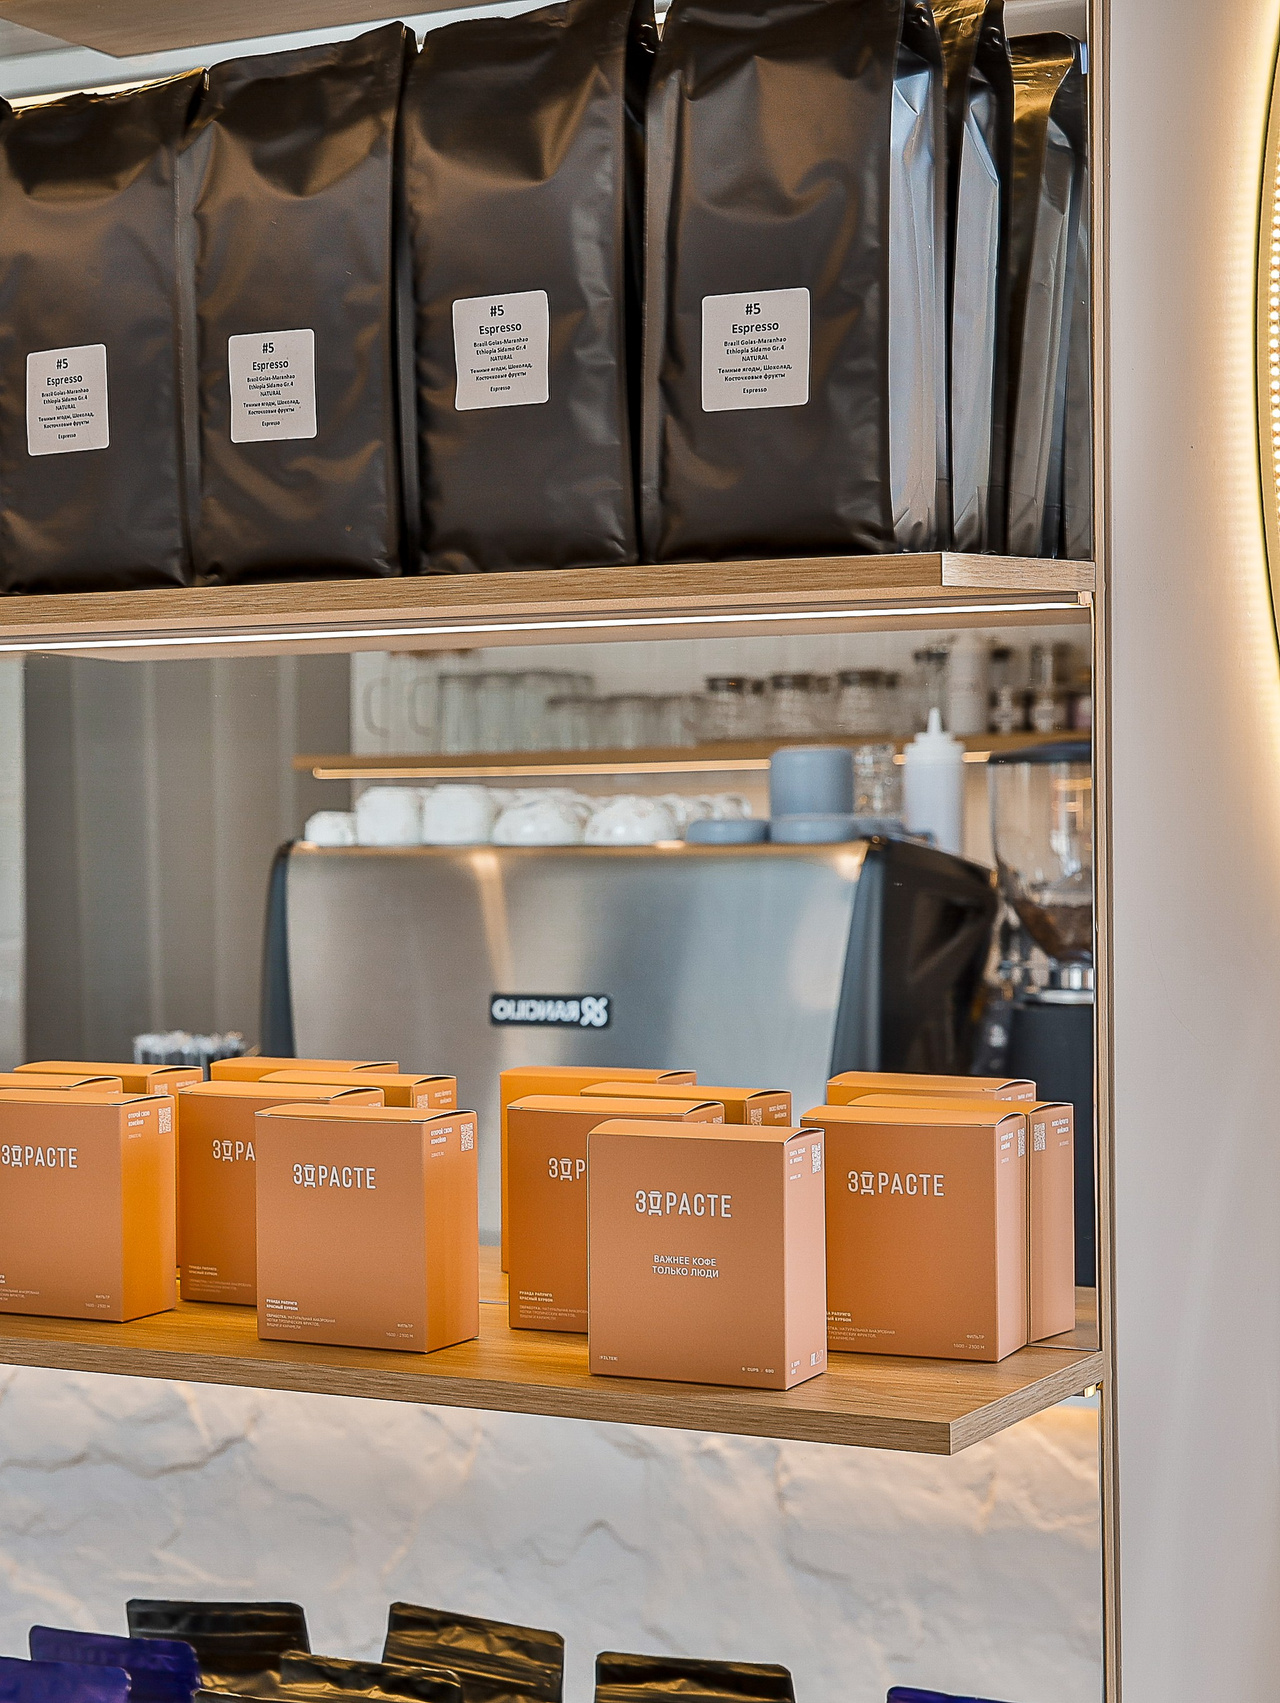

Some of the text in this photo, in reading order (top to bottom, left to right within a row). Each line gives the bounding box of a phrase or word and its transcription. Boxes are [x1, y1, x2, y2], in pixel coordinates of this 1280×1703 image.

[490, 305, 504, 317] #5
[745, 303, 761, 315] #5
[479, 323, 522, 336] Espresso
[732, 322, 779, 335] Espresso
[262, 342, 275, 354] #5
[56, 358, 68, 370] #5
[252, 360, 289, 372] Espresso
[46, 374, 83, 387] Espresso
[212, 1139, 256, 1162] ЗДРА
[653, 1254, 717, 1267] ВАЖНЕЕ КОФЕ
[652, 1266, 719, 1279] ТОЛЬКО ЛЮДИ
